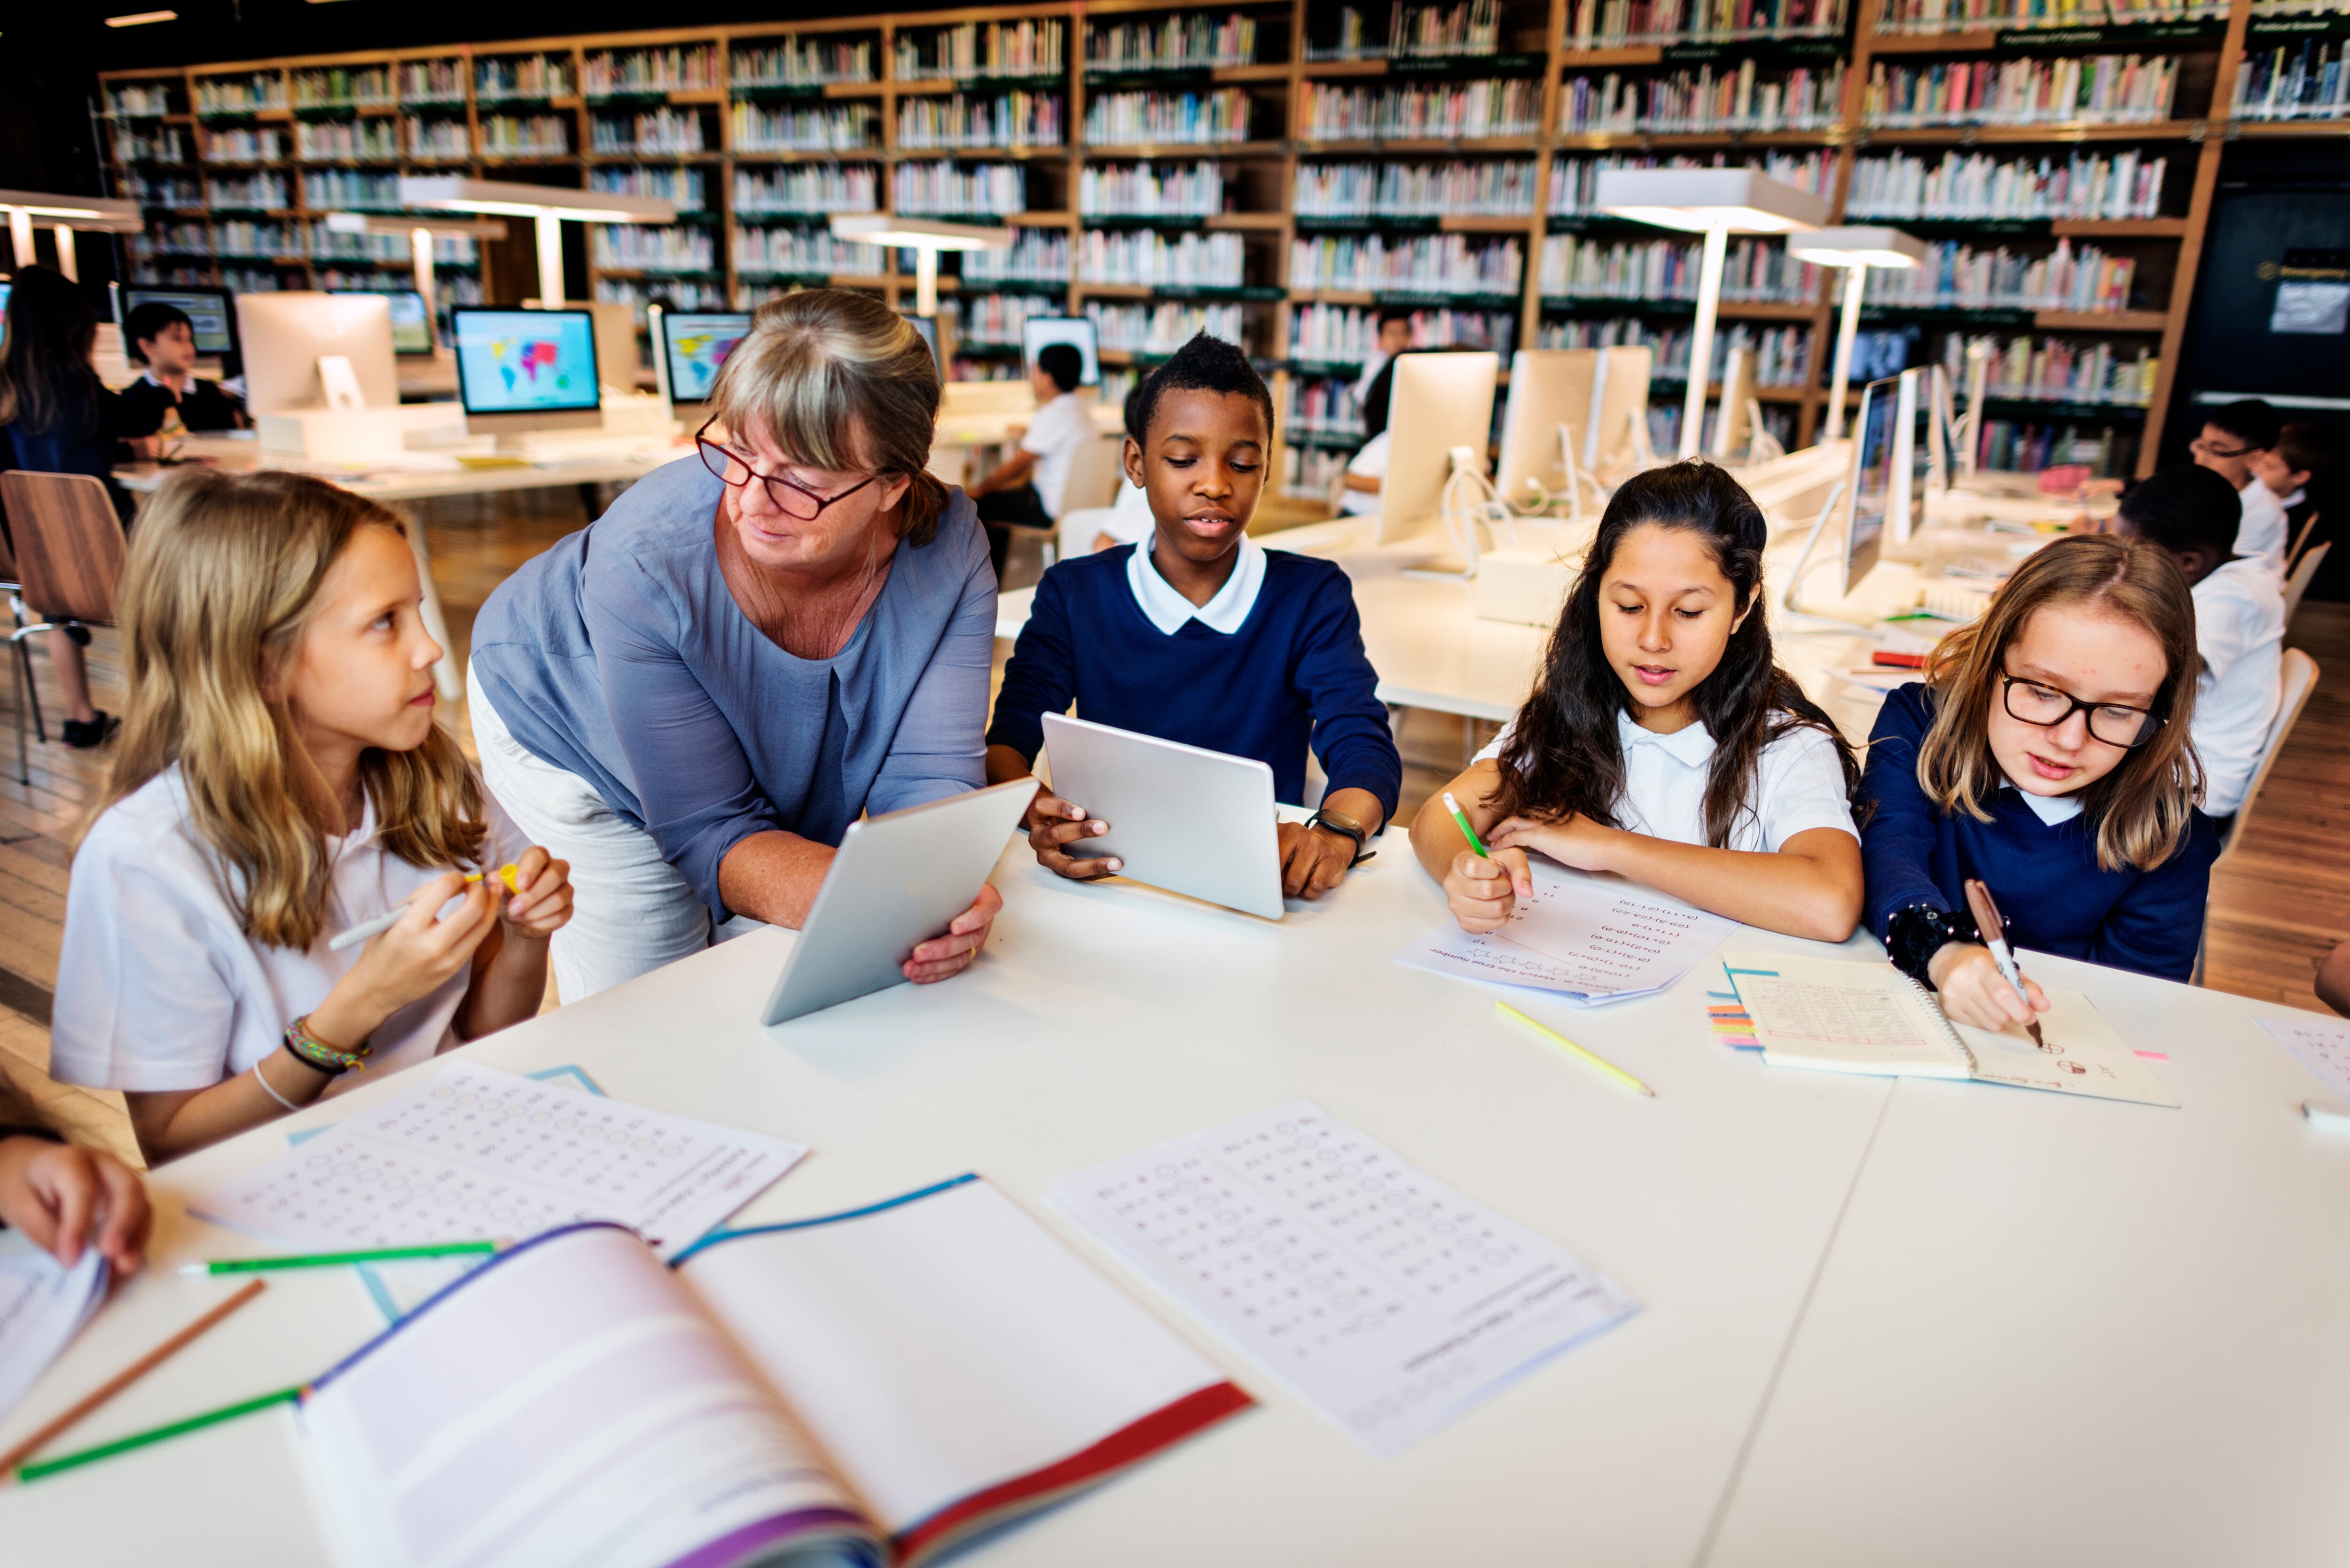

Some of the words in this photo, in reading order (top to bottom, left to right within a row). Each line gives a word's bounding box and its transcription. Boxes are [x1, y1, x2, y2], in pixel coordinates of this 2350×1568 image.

[1429, 948, 1470, 962] number
[1471, 960, 1495, 968] true
[1519, 971, 1556, 981] Match
